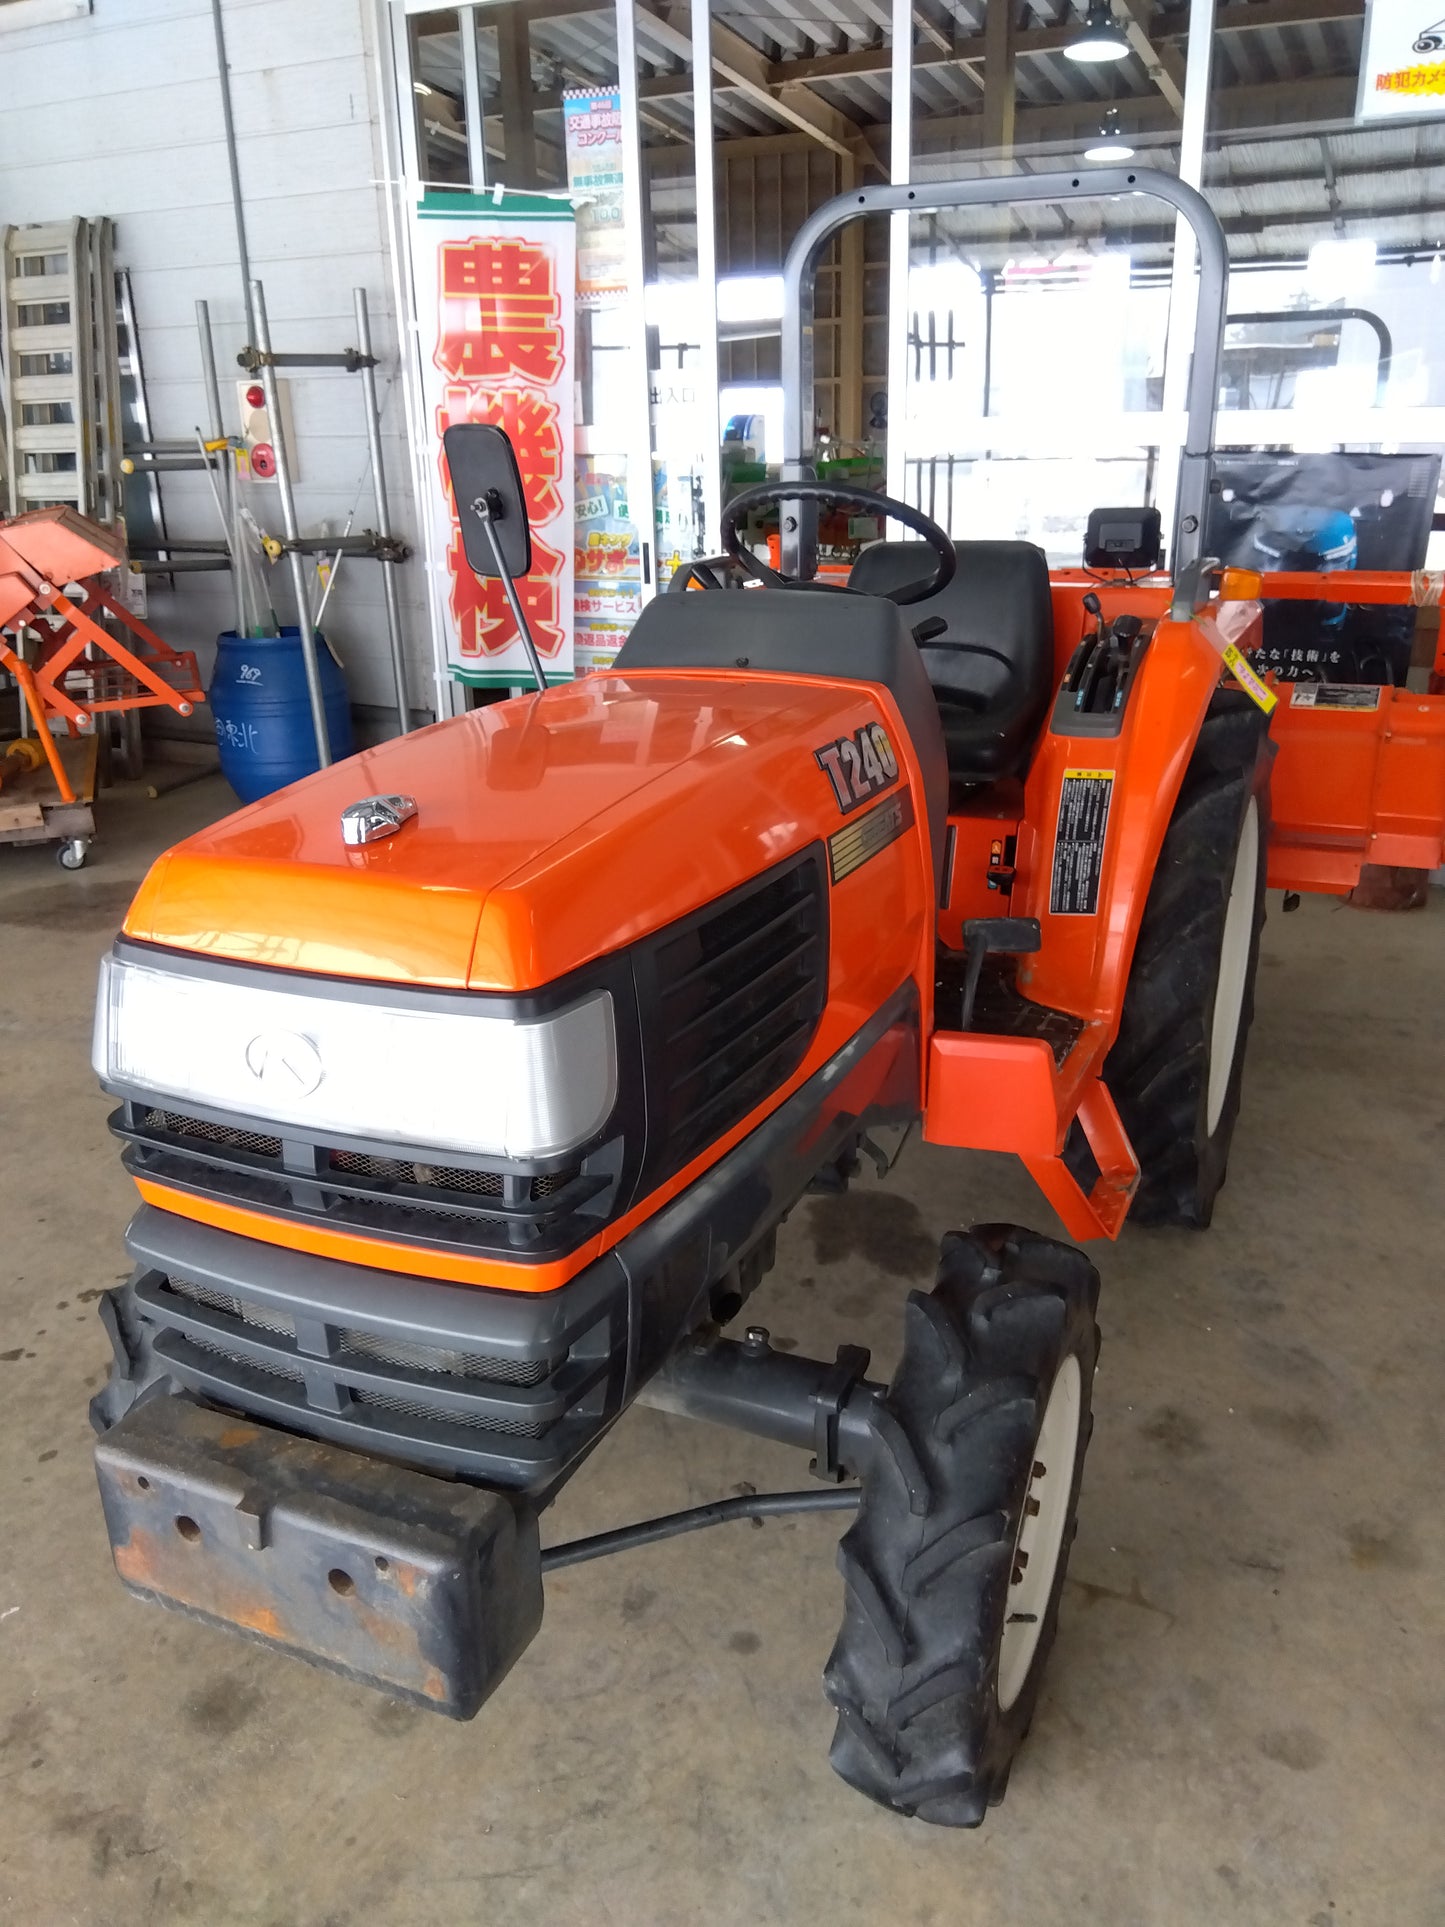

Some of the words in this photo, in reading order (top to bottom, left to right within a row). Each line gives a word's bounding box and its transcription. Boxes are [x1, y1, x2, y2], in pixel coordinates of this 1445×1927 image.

[1375, 70, 1445, 91] 防犯カメ
[649, 386, 695, 404] 出入口
[1241, 647, 1341, 664] たな「技術」を
[814, 721, 899, 815] T240
